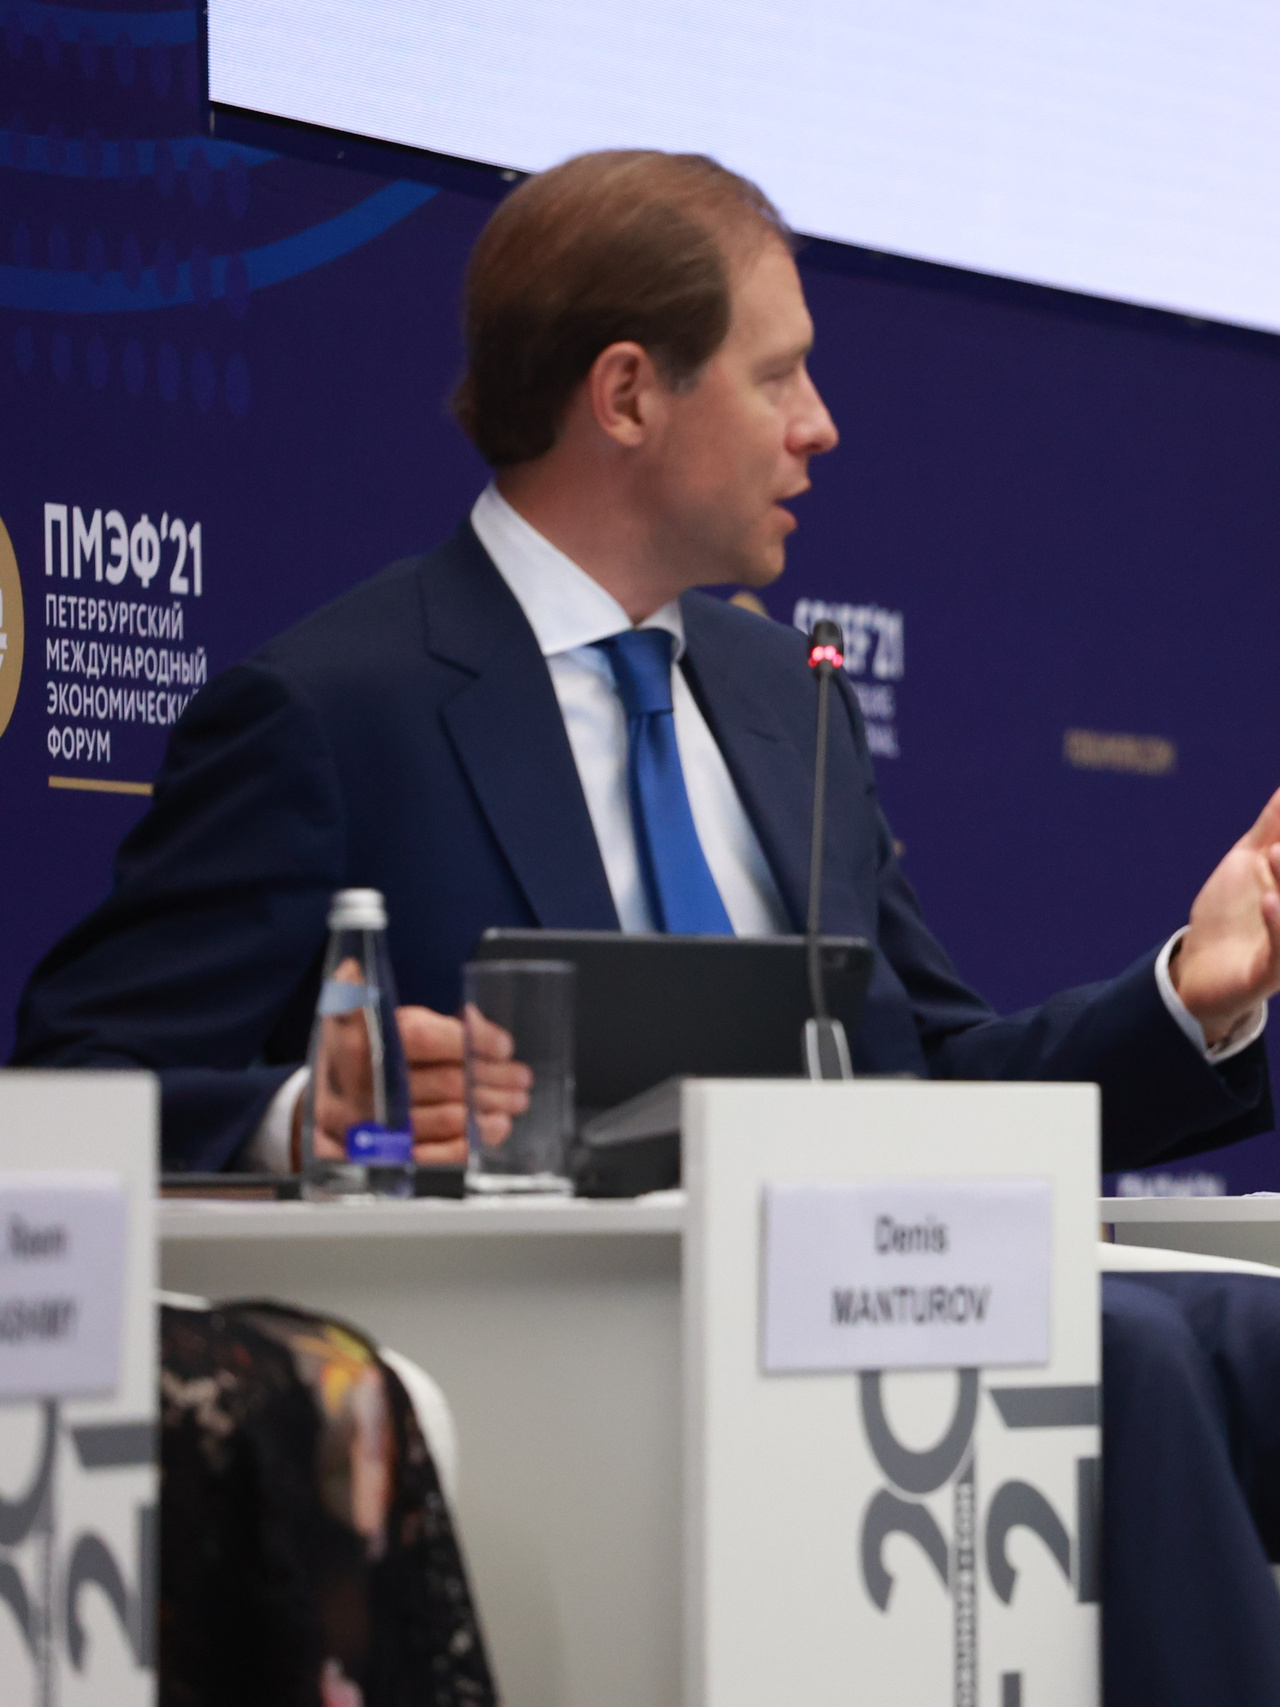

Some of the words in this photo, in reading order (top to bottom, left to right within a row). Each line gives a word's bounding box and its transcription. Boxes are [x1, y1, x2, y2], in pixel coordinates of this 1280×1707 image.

[44, 502, 203, 597] ПМЭФ'21
[45, 593, 184, 641] ПЕТЕРБУРГСКИЙ
[46, 637, 207, 688] МЕЖДУНАРОДНЫЙ
[46, 681, 199, 726] ЭКОНОМИЧЕСКИ
[47, 726, 111, 763] ФОРУМ
[875, 1214, 949, 1254] Denis
[831, 1284, 991, 1326] MANTUROV
